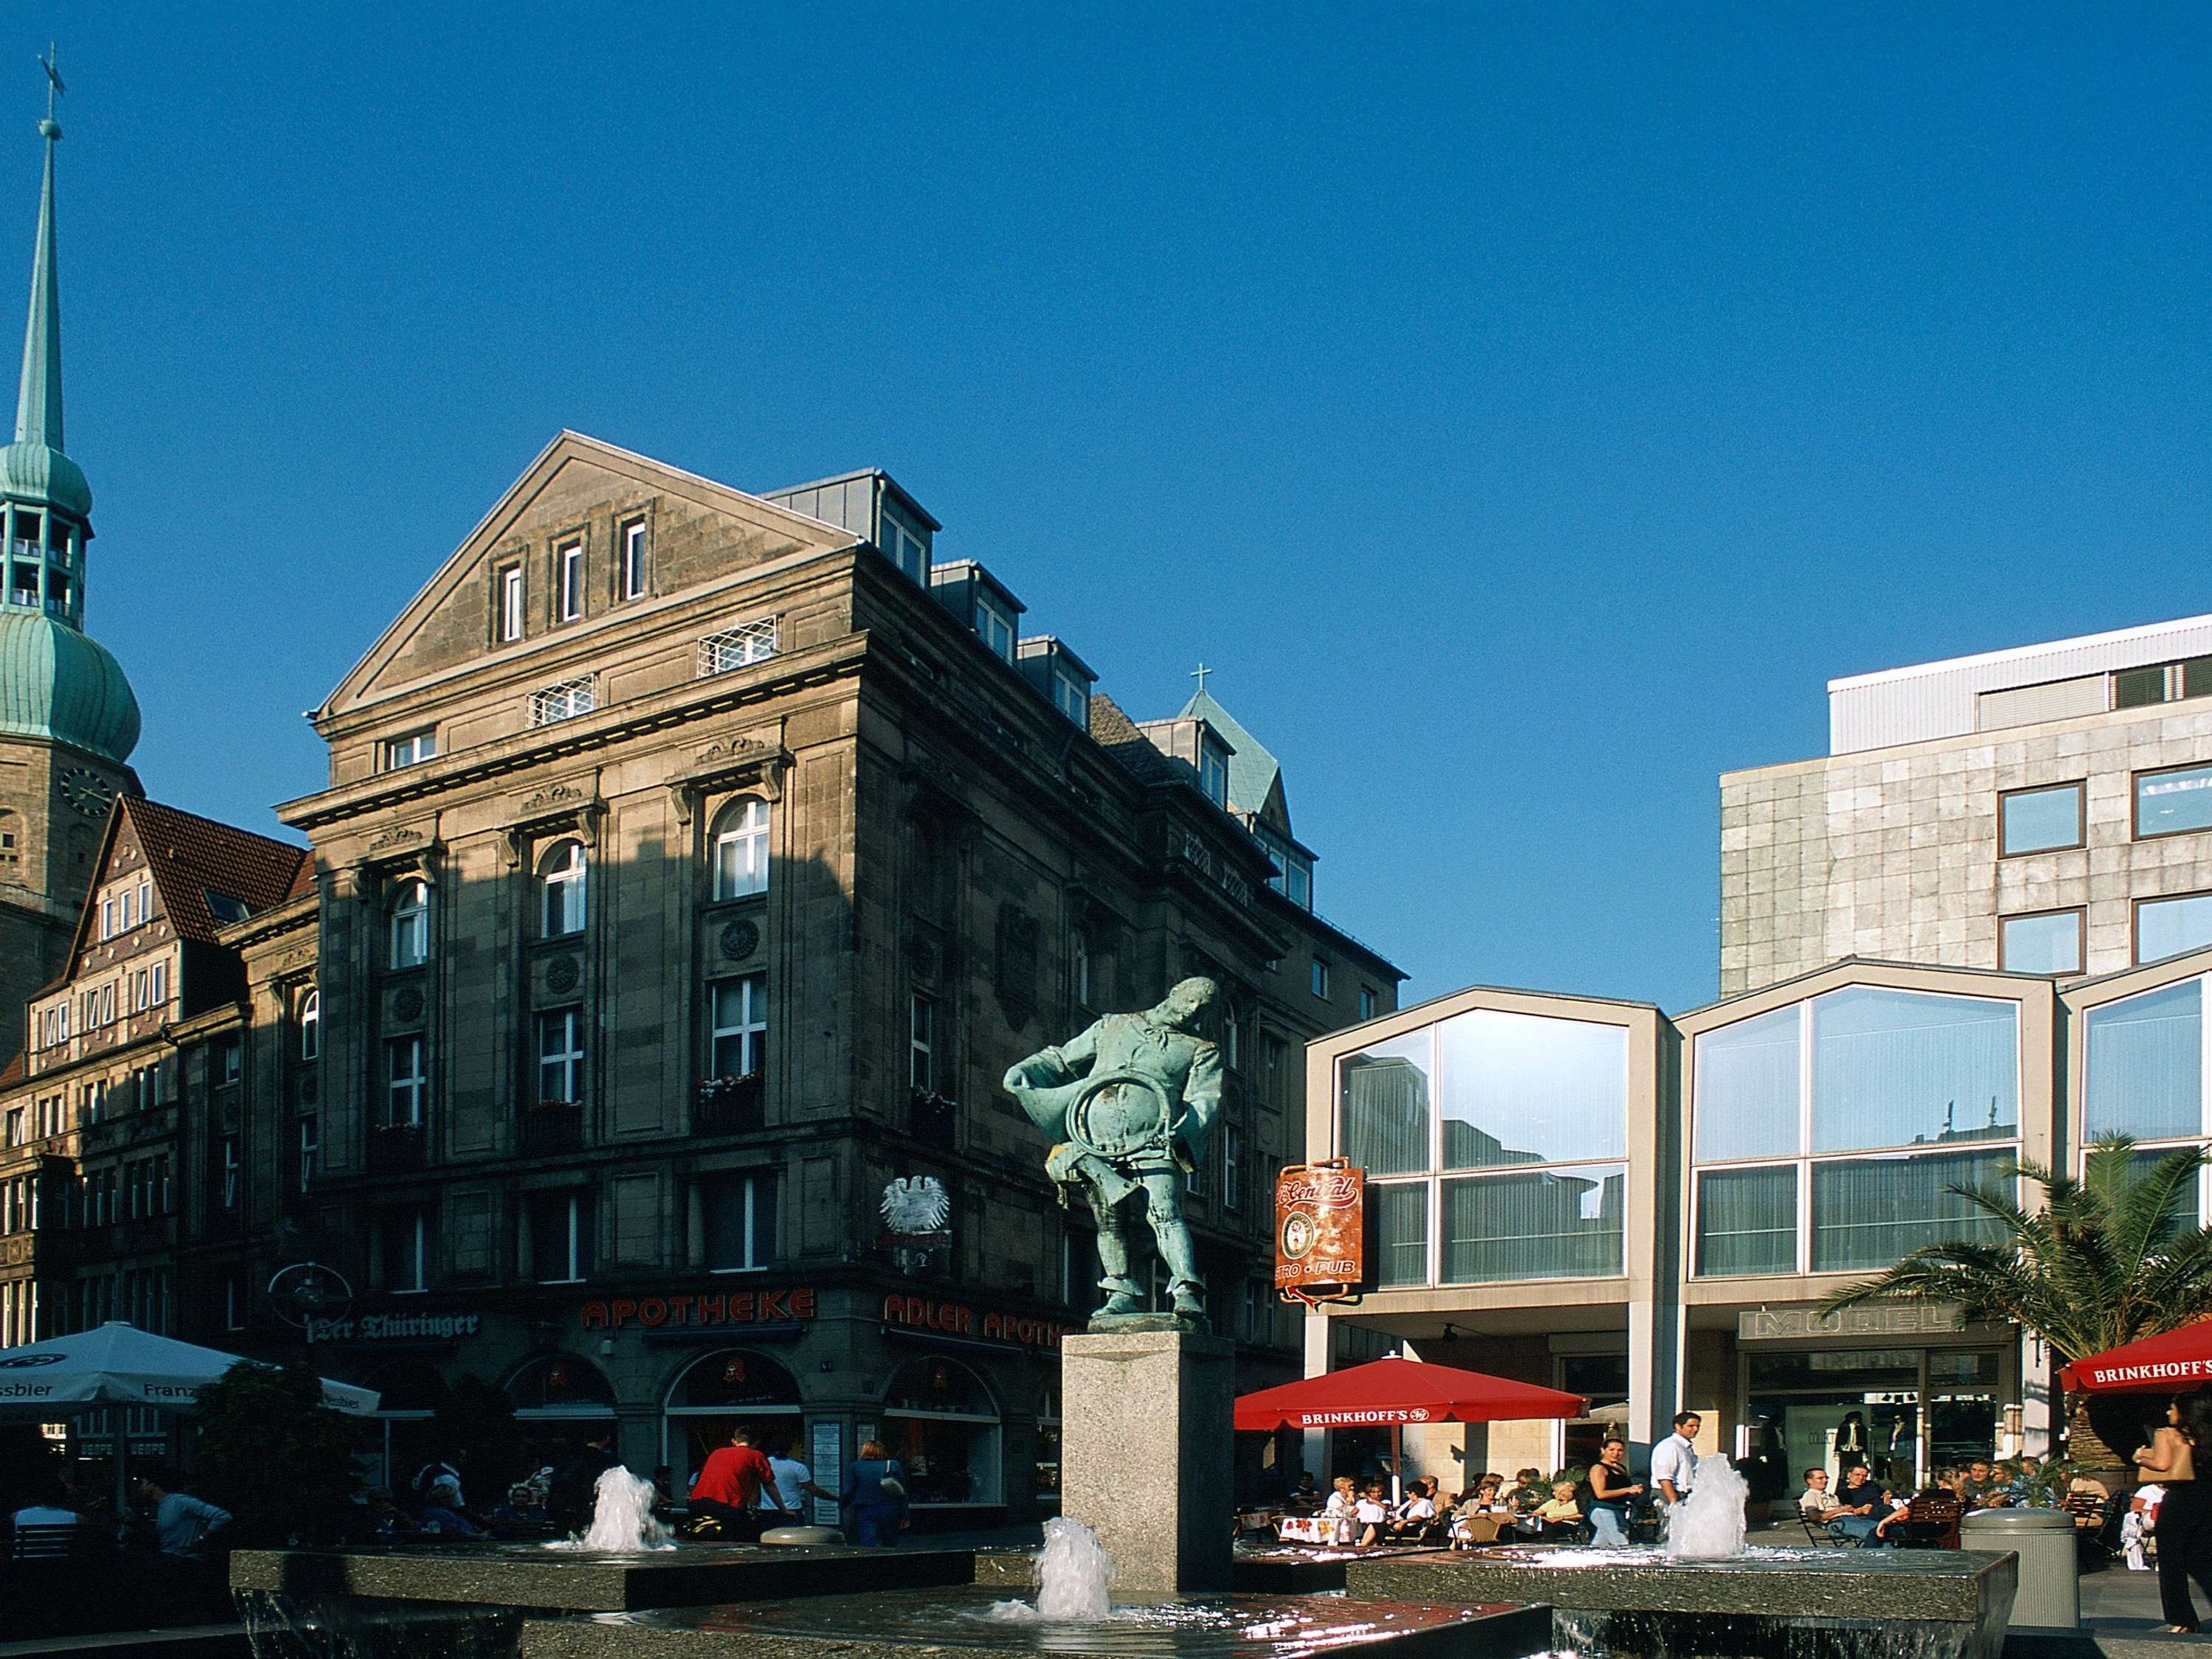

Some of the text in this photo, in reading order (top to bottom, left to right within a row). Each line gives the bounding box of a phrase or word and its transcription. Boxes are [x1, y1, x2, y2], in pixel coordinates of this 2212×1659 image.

[1315, 1260, 1355, 1274] PUB
[581, 1287, 815, 1327] APOTHEKE
[883, 1292, 1086, 1347] ADLER APOTH
[361, 1312, 479, 1338] Thüringer
[1755, 1307, 1952, 1335] MODEL
[2094, 1360, 2212, 1383] BRINKHOFF'S
[1301, 1410, 1408, 1425] BRINKHOFF'S
